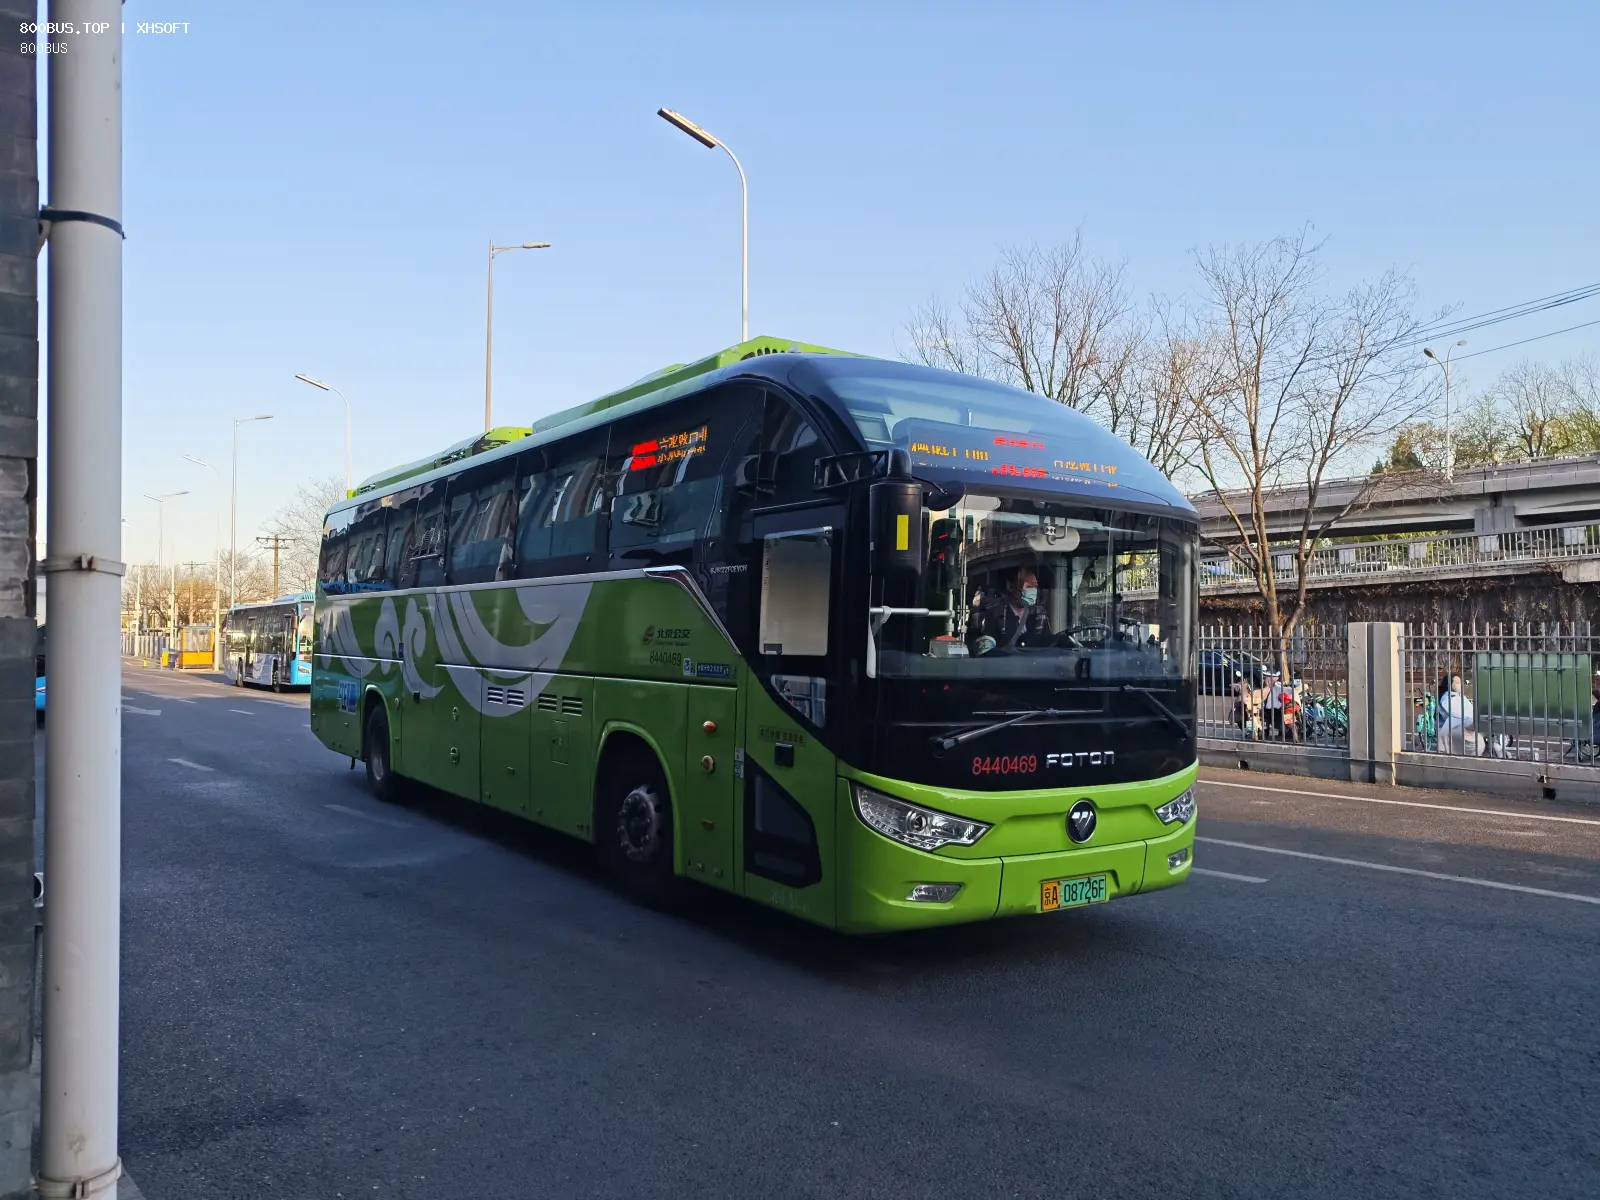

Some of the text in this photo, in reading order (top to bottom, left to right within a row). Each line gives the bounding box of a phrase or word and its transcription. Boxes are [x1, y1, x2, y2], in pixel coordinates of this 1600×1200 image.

[656, 628, 691, 639] 北京公交
[649, 650, 682, 667] 8440469
[972, 755, 1037, 775] 8440469
[1046, 750, 1115, 769] FOTON
